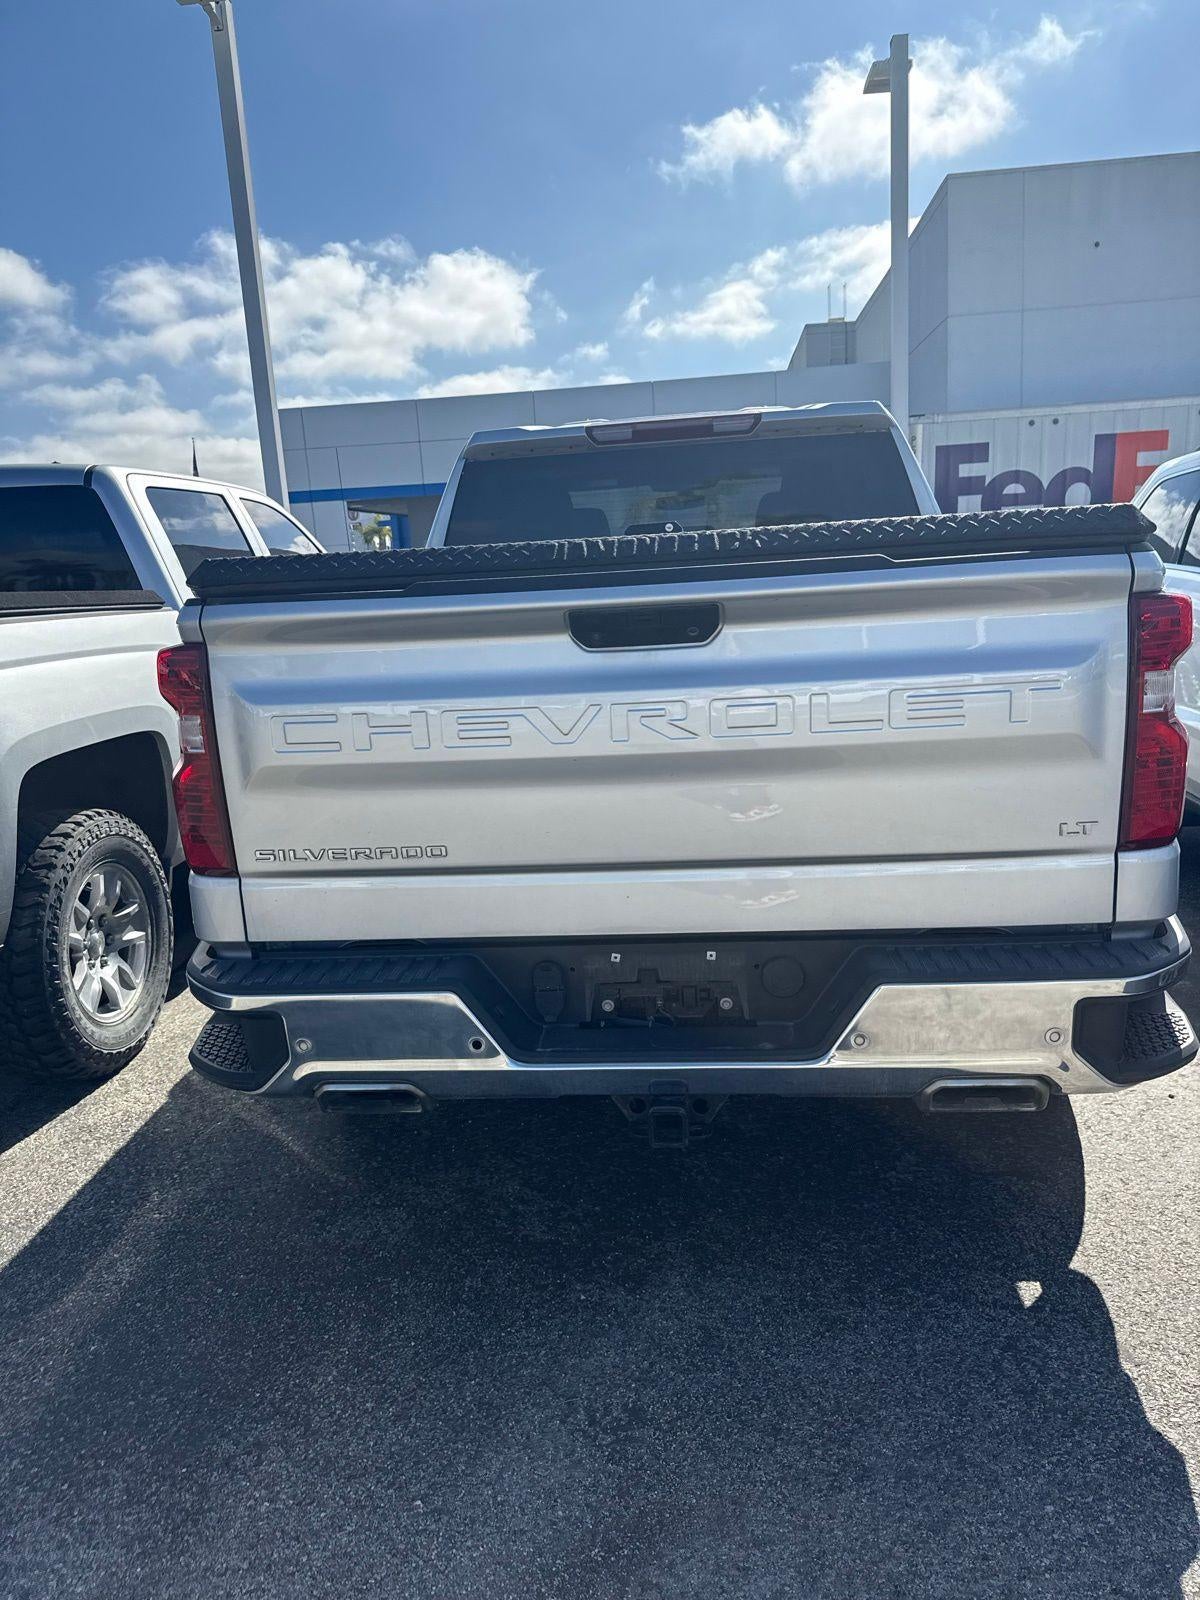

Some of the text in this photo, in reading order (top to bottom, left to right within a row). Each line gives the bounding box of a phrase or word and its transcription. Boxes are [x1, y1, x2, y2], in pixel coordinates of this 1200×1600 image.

[935, 429, 1169, 513] FedE
[269, 679, 1063, 754] CHEVROLET
[1059, 820, 1098, 837] LT
[254, 845, 448, 862] SILVERADO
